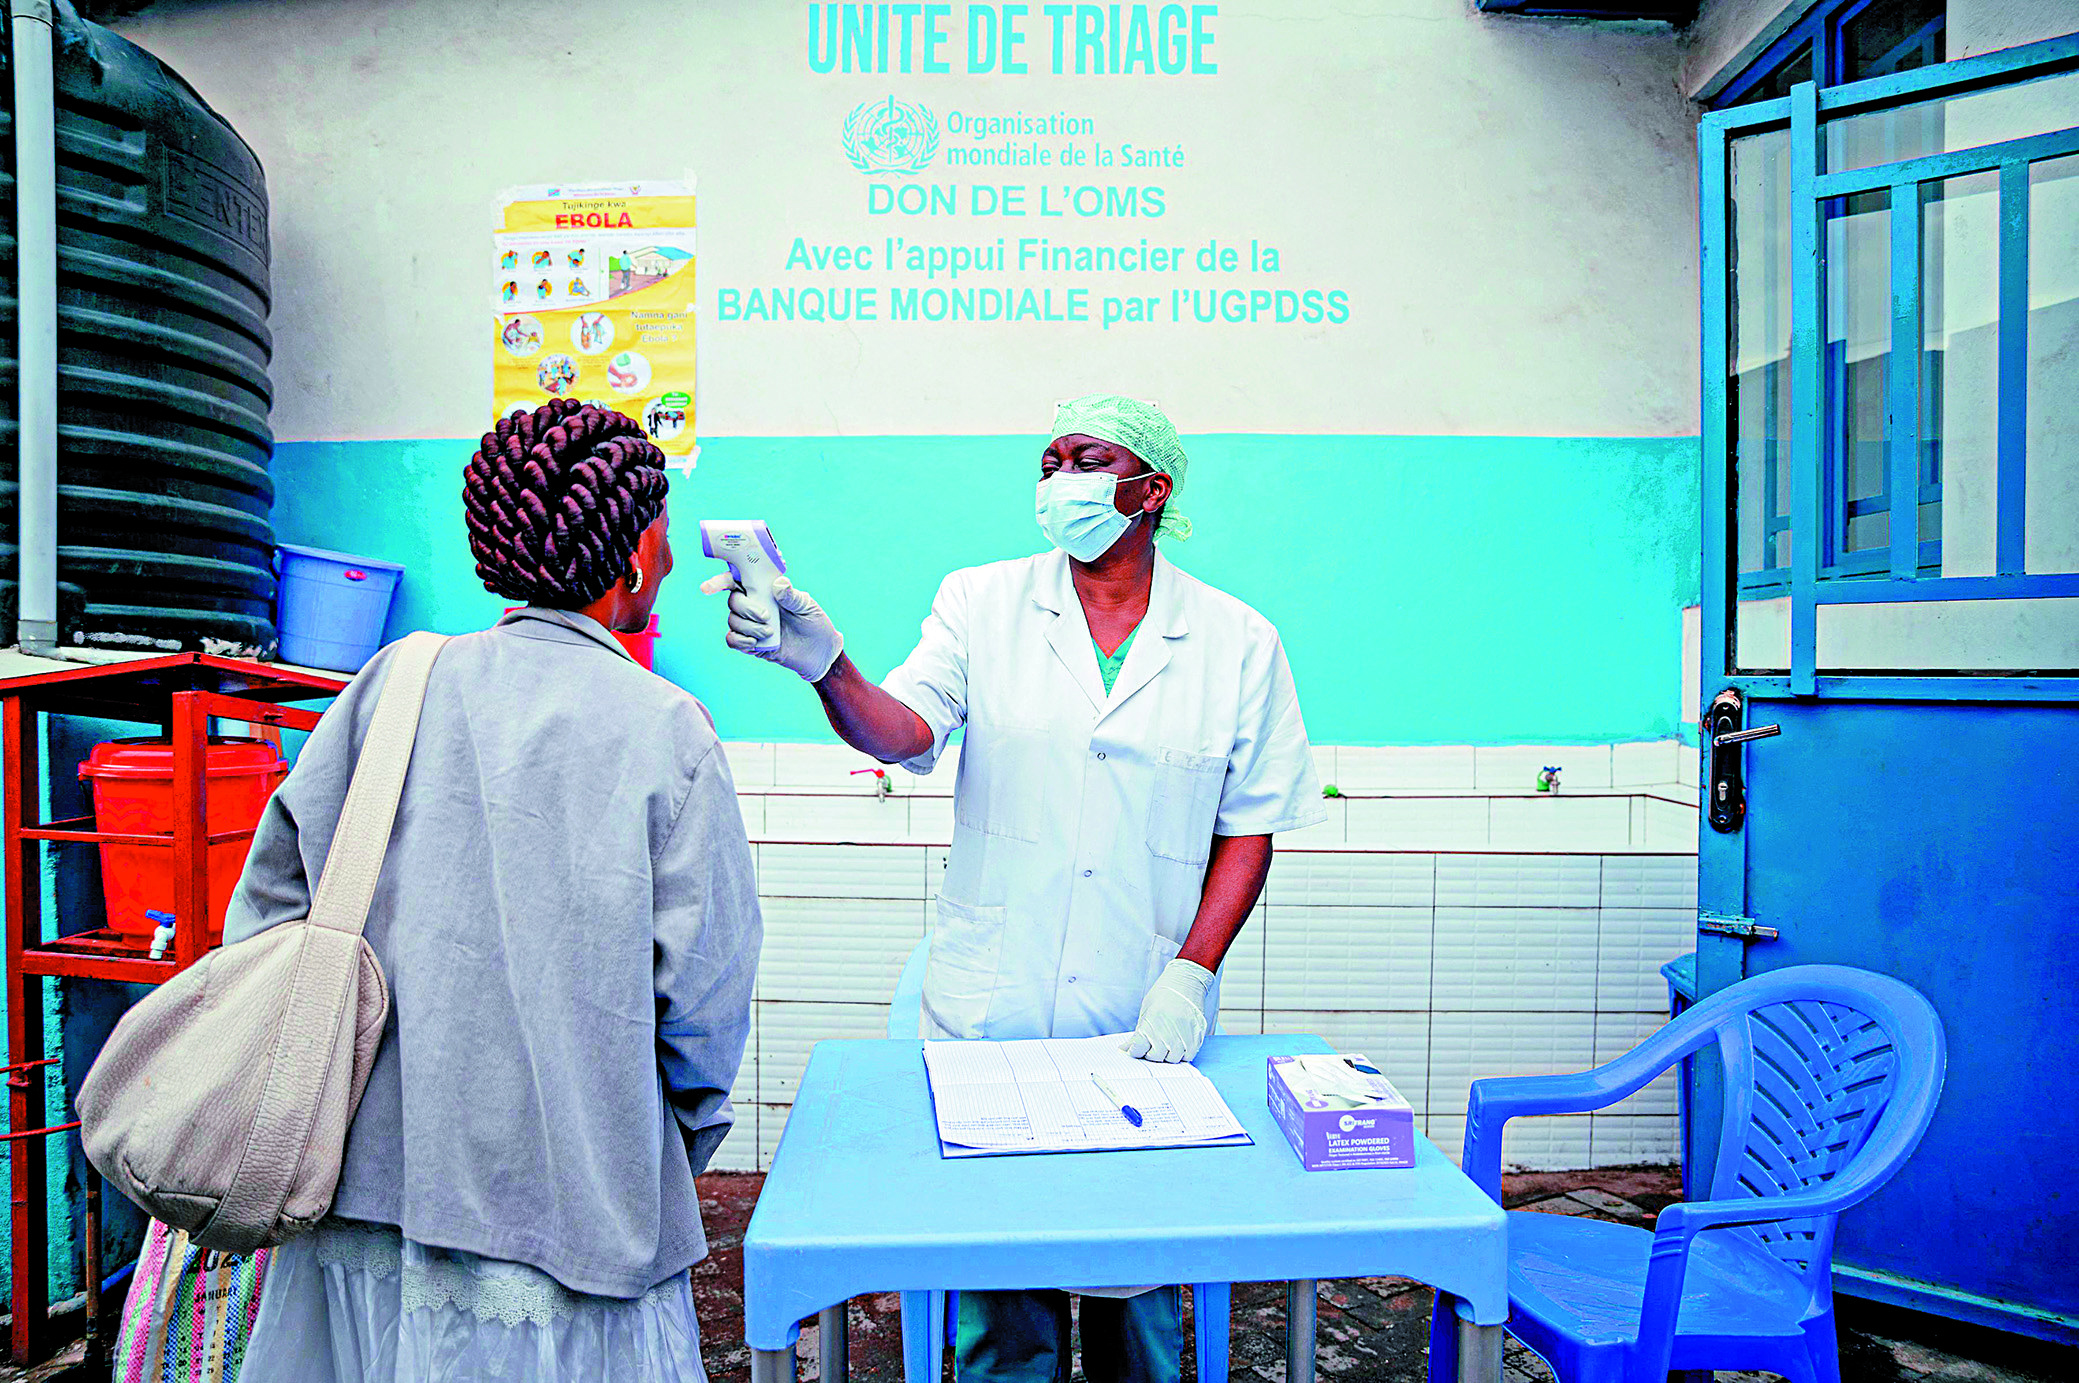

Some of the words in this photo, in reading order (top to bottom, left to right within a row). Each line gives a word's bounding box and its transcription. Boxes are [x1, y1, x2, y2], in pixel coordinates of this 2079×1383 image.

[807, 3, 951, 75] UNITE
[967, 4, 1029, 75] DE
[1043, 3, 1218, 76] TRIAGE
[947, 111, 1094, 139] Organisation
[946, 142, 1052, 167] mondiale
[1059, 142, 1086, 167] de
[1094, 142, 1113, 168] la
[1120, 142, 1185, 169] Santé
[563, 201, 605, 211] Tujikinge
[868, 184, 957, 217] DON
[971, 185, 1026, 217] DE
[555, 212, 634, 229] EBOLA
[785, 237, 873, 272] Avec
[1018, 238, 1185, 273] Financier
[1196, 239, 1238, 273] de
[1251, 240, 1280, 273] la
[631, 311, 664, 319] Namna
[667, 312, 687, 320] gani
[717, 287, 877, 324] BANQUE
[891, 287, 1089, 322] MONDIALE
[1103, 296, 1161, 330] par
[642, 334, 668, 342] Ebola
[1328, 1139, 1350, 1147] LATEX
[1350, 1137, 1390, 1146] POWDERED
